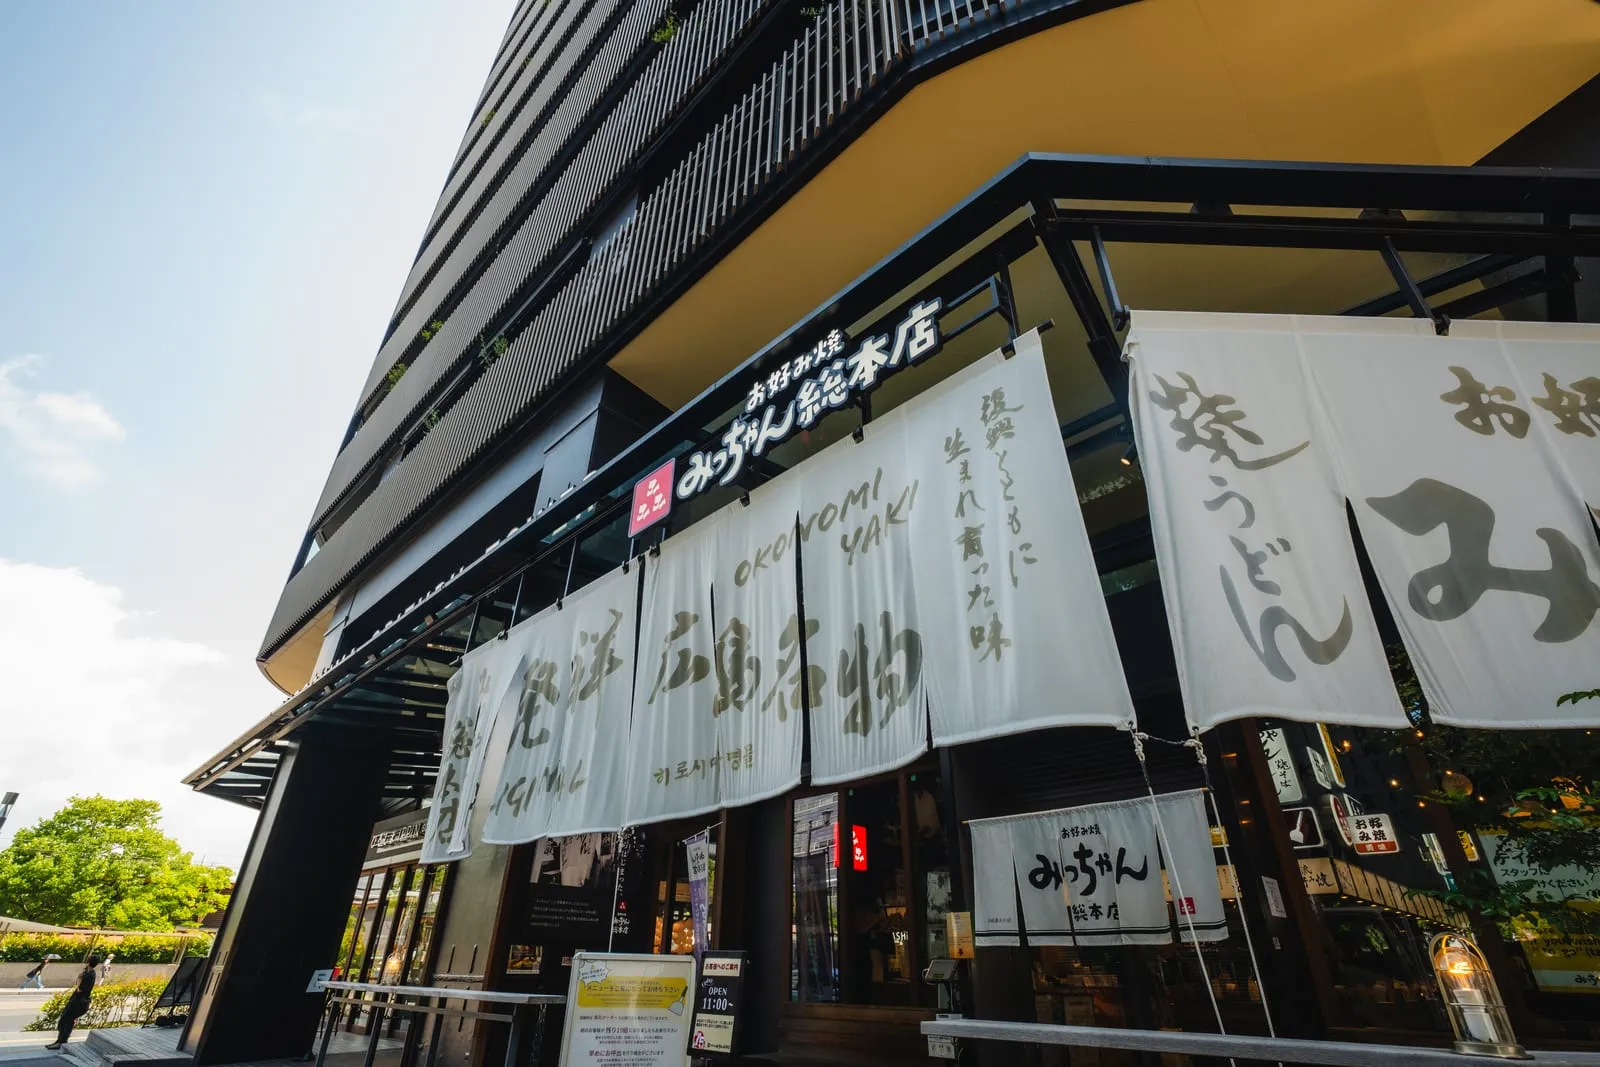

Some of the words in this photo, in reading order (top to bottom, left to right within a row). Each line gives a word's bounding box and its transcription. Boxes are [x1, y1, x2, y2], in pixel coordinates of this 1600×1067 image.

[746, 328, 844, 413] お好み焼
[734, 467, 882, 587] OKONOMI
[840, 479, 920, 566] YAKI
[943, 427, 1012, 663] 生まれ育った味
[1028, 842, 1148, 897] みっちゃん
[708, 987, 728, 996] OPEN
